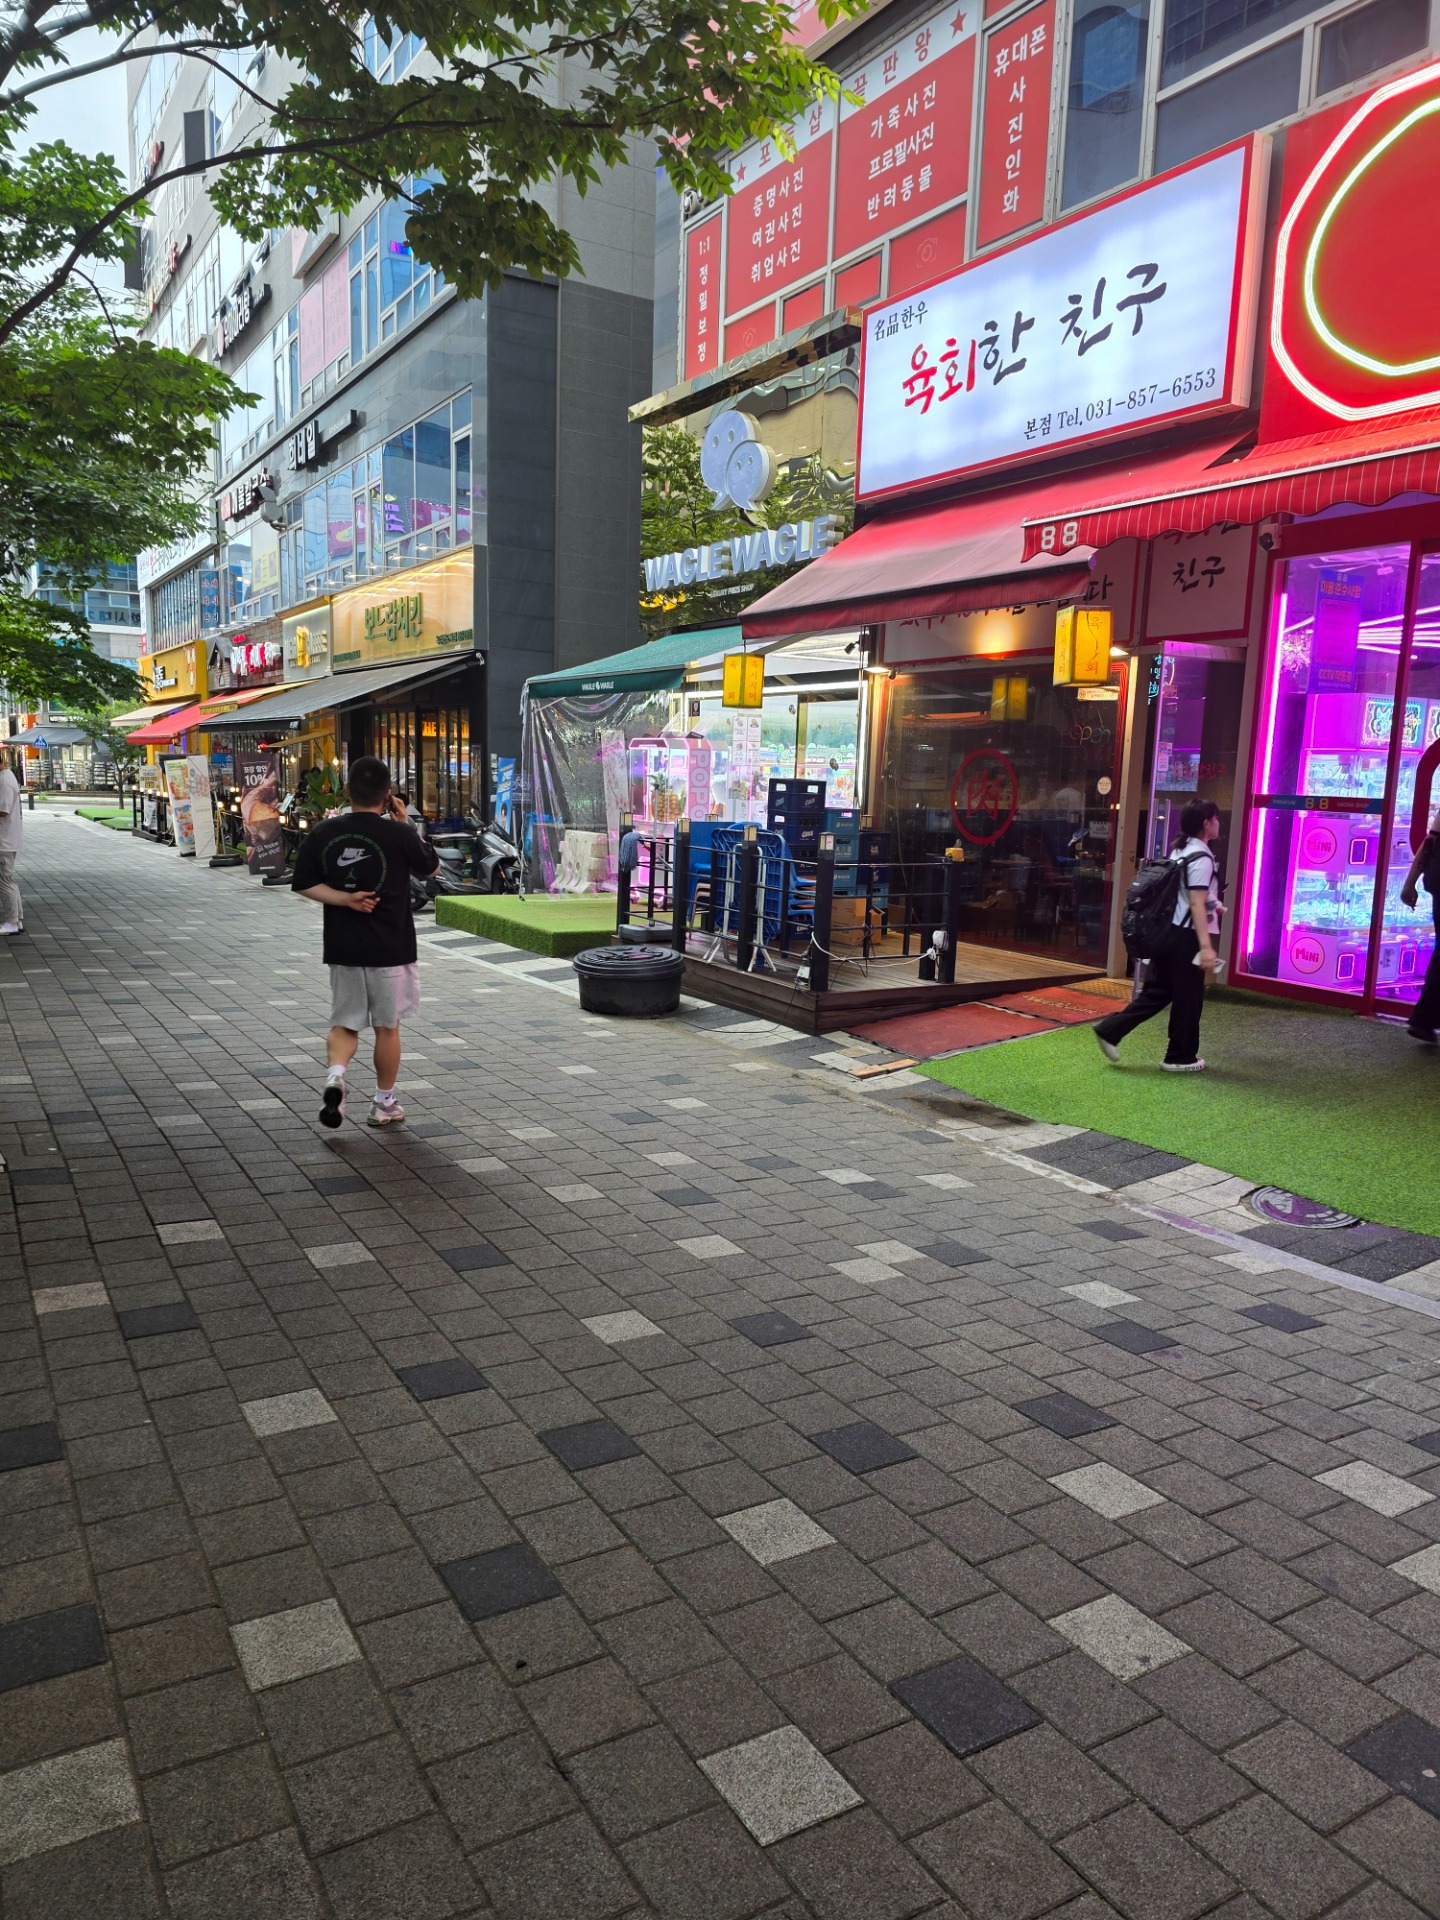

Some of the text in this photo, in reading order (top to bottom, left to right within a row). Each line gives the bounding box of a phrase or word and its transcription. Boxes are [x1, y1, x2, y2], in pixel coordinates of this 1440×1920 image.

[993, 23, 1048, 78] 휴대폰
[870, 80, 937, 141] 가족사진
[867, 121, 935, 181] 프로필사진
[1001, 76, 1027, 215] 사진인화
[752, 167, 805, 219] 증명사진
[866, 168, 933, 221] 반려동물
[699, 235, 711, 256] 1:1
[751, 203, 803, 249] 여권사진
[750, 238, 802, 284] 취업사진
[873, 300, 929, 342] 名品한우
[902, 262, 1168, 415] 육회한 친구
[1023, 412, 1052, 440] 본점
[1085, 367, 1217, 422] 031-857-6553
[644, 514, 835, 593] WAGLE WAGLE
[1040, 521, 1078, 550] 88
[741, 583, 755, 593] SHOP
[1173, 555, 1225, 592] 친구
[364, 592, 424, 641] 보드람치킨
[244, 773, 269, 786] 10%
[342, 847, 366, 859] NIKE
[1306, 839, 1333, 853] MiNi
[1295, 947, 1320, 963] MiNi
